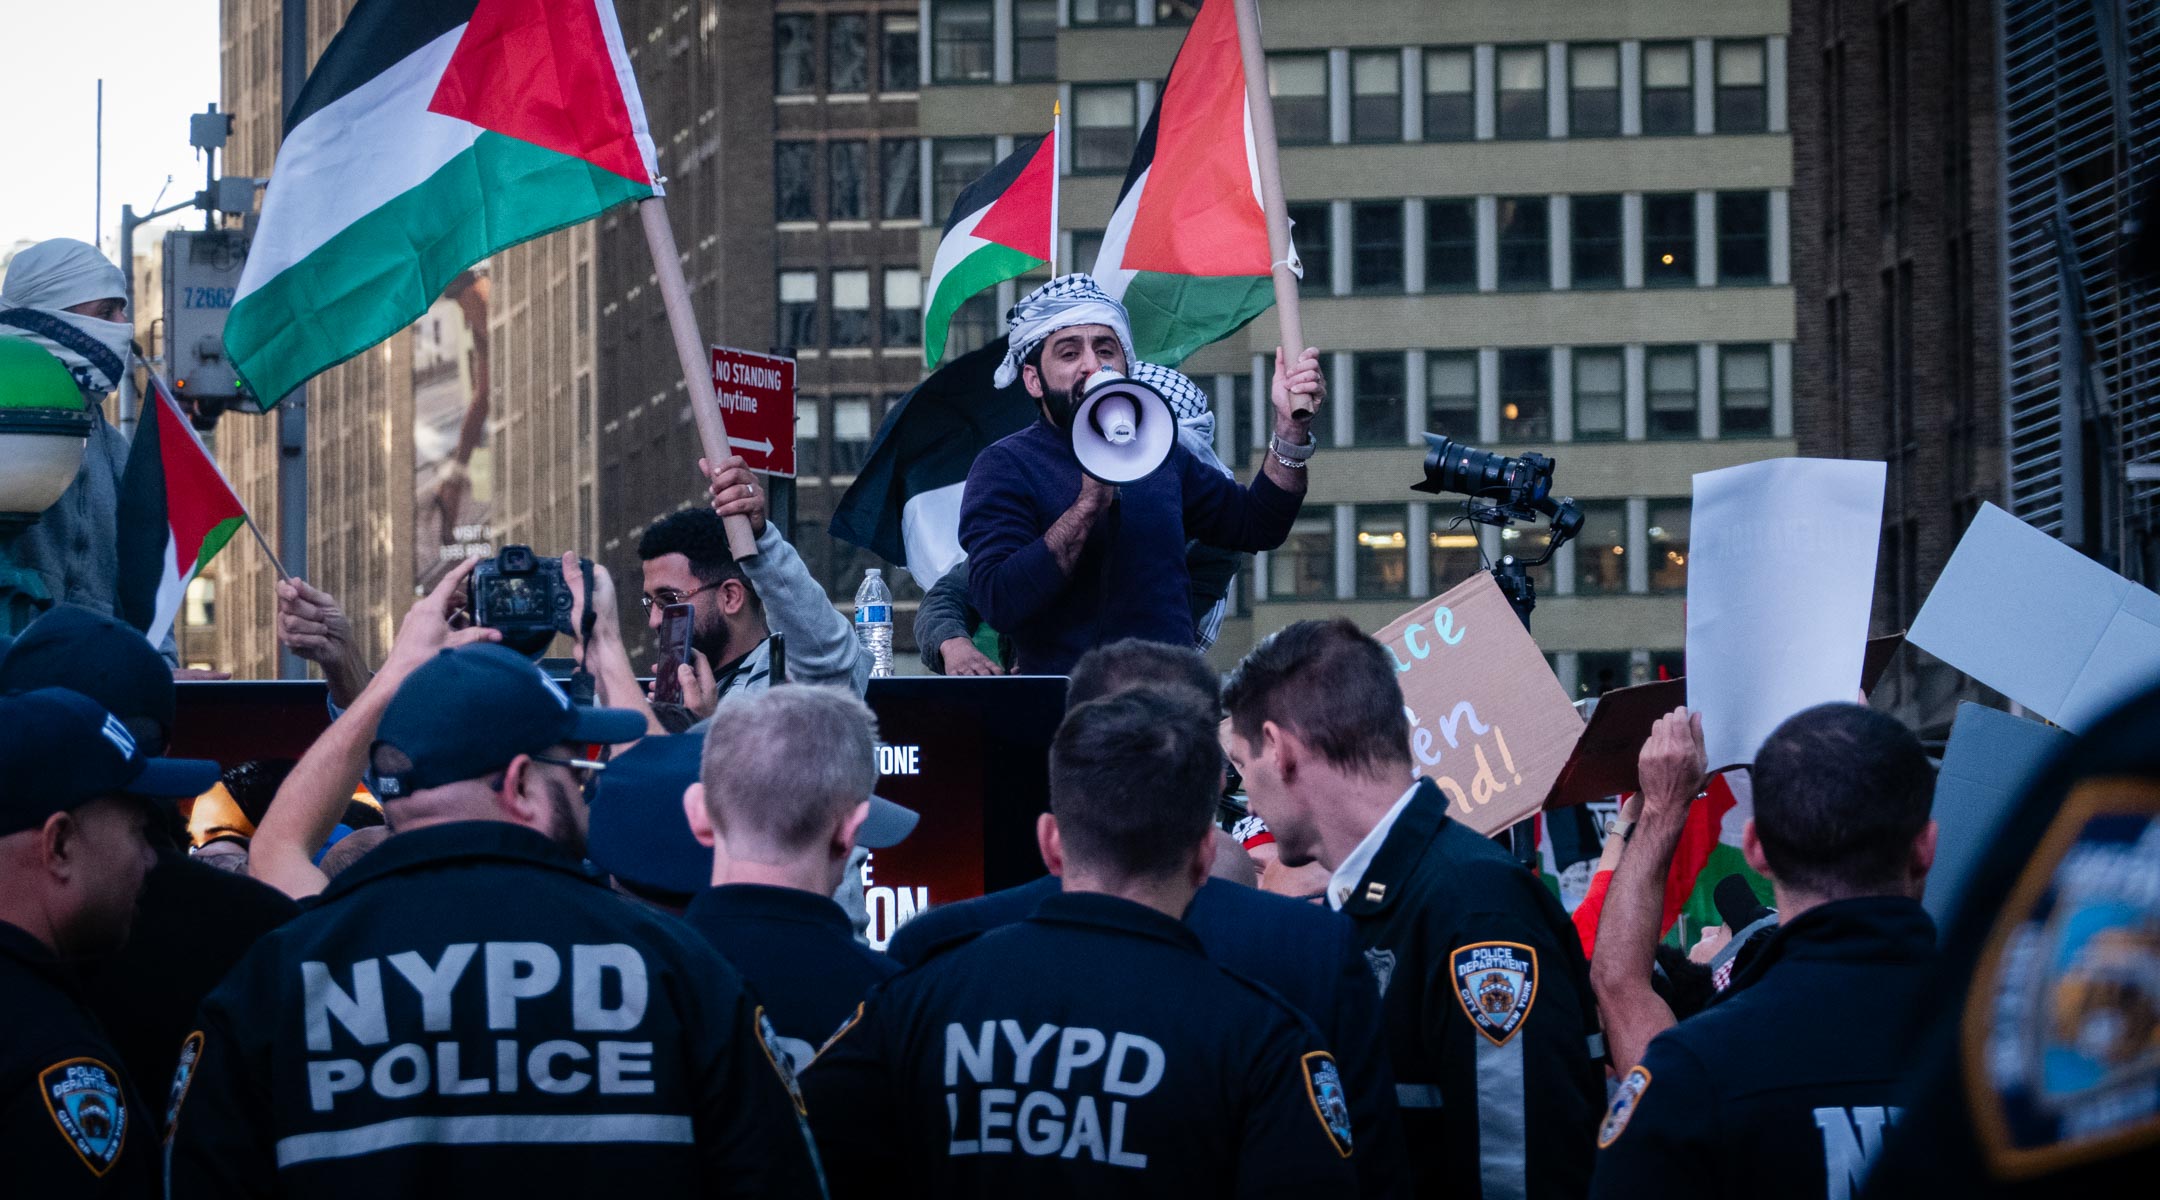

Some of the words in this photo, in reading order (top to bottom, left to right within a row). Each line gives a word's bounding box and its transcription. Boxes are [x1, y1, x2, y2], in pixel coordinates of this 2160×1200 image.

[716, 360, 730, 382] NO
[733, 362, 782, 391] STANDING
[717, 387, 757, 414] Anytime
[1457, 958, 1530, 977] DEPARTMENT
[1472, 947, 1513, 960] POLICE
[301, 941, 649, 1051] NYPD
[1461, 989, 1479, 1012] CITY
[944, 1019, 1166, 1097] NYPD
[307, 1039, 655, 1110] POLICE
[946, 1088, 1148, 1169] LEGAL
